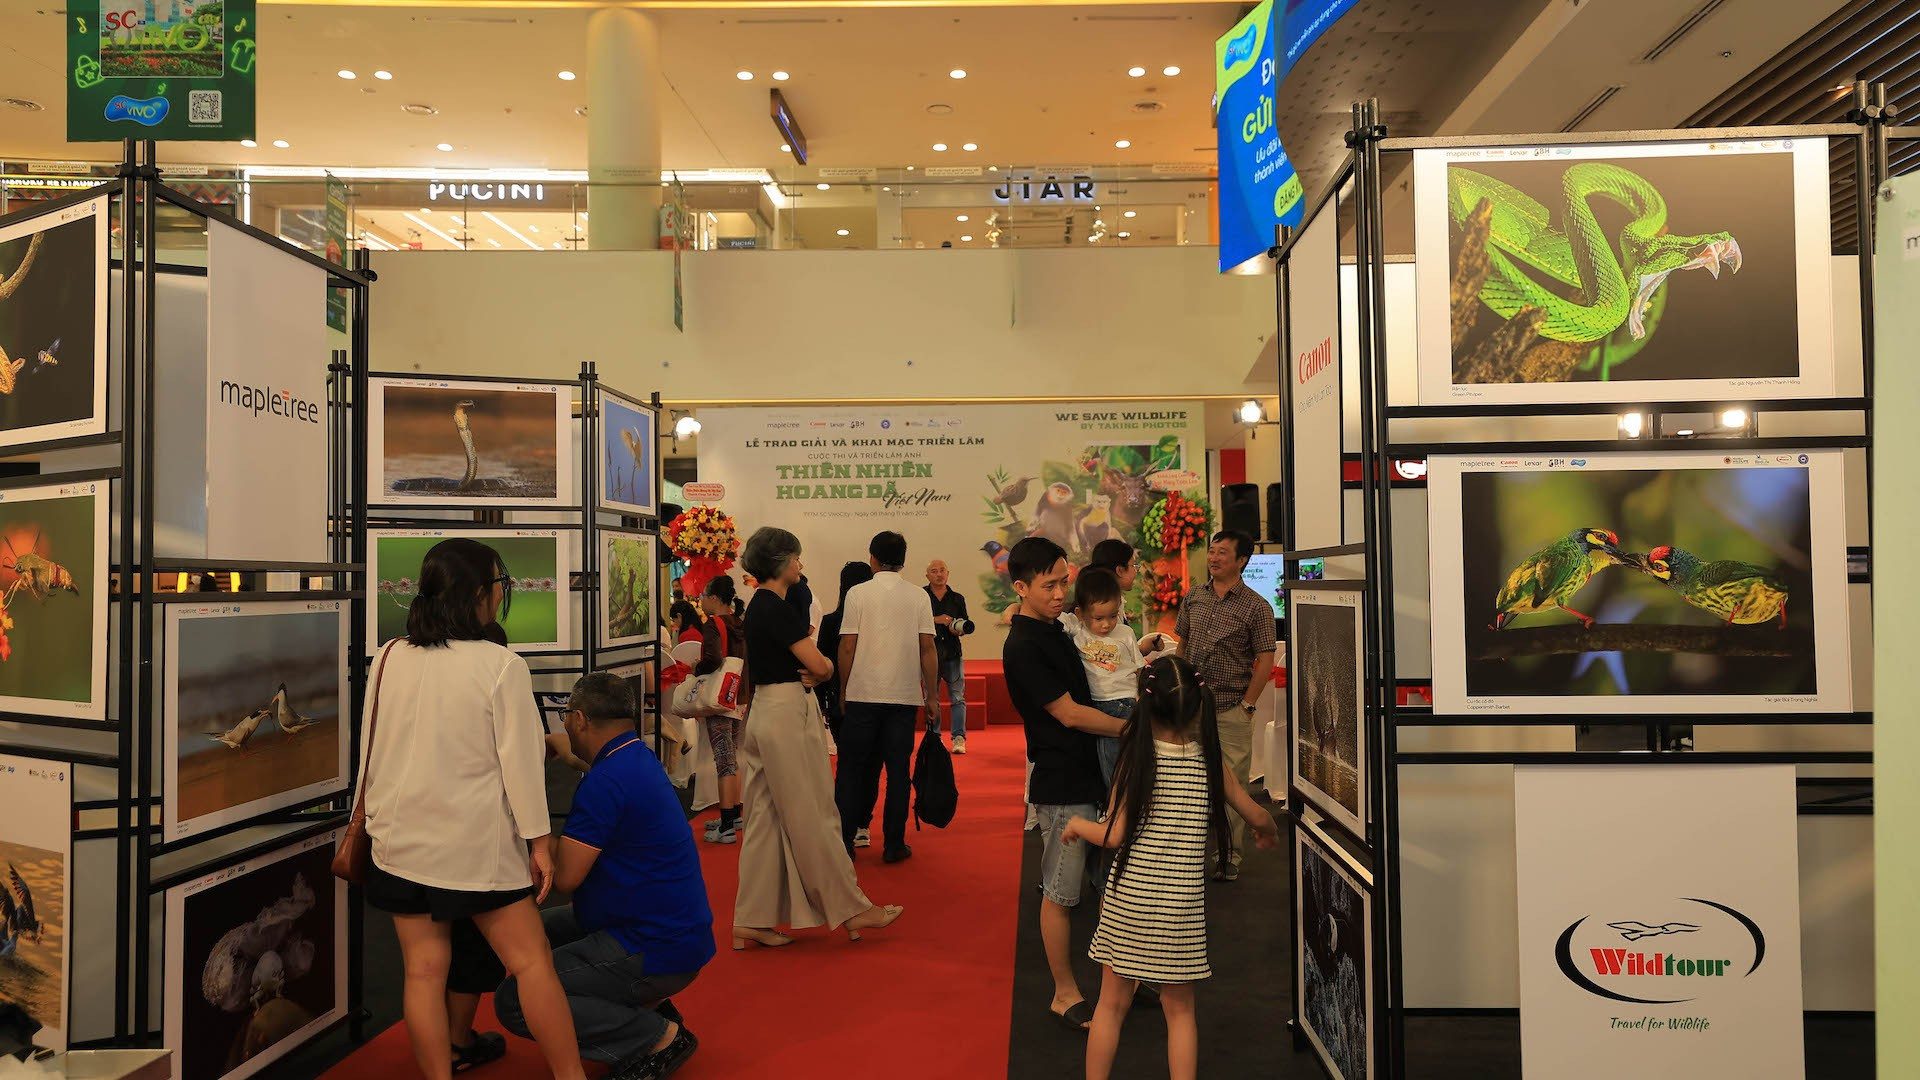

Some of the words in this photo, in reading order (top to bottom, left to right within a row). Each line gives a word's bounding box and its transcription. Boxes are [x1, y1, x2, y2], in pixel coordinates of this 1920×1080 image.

[105, 10, 137, 31] SC
[429, 182, 545, 201] PUCINI
[1298, 336, 1331, 385] Canon
[220, 379, 319, 425] mapletree
[767, 421, 800, 429] mapletree
[1056, 413, 1079, 421] WE
[1083, 412, 1117, 421] SAVE
[1121, 411, 1187, 420] WILDLIFE
[1098, 422, 1139, 430] TAKING
[1143, 421, 1187, 429] PHOTOS
[746, 437, 760, 448] LỄ
[763, 439, 797, 448] TRAO
[801, 437, 827, 447] GIẢI
[832, 437, 848, 447] VÀ
[852, 438, 882, 447] KHAI
[887, 438, 914, 449] MẠC
[917, 434, 955, 446] TRIỂN
[959, 435, 985, 446] LÃM
[807, 452, 830, 460] CUỘC
[832, 452, 847, 460] THI
[848, 451, 859, 459] VÀ
[860, 451, 884, 459] TRIỂN
[776, 461, 852, 480] THIÊN
[855, 460, 933, 479] NHIÊN
[776, 484, 864, 500] HOANG
[866, 480, 901, 499] DÃ
[882, 489, 915, 509] Việt
[914, 487, 952, 507] Nam
[878, 510, 896, 518] tháng
[1589, 948, 1732, 977] Wildtour
[1610, 1016, 1647, 1030] Travel
[1648, 1017, 1665, 1032] for
[1664, 1016, 1711, 1032] Wildlife
